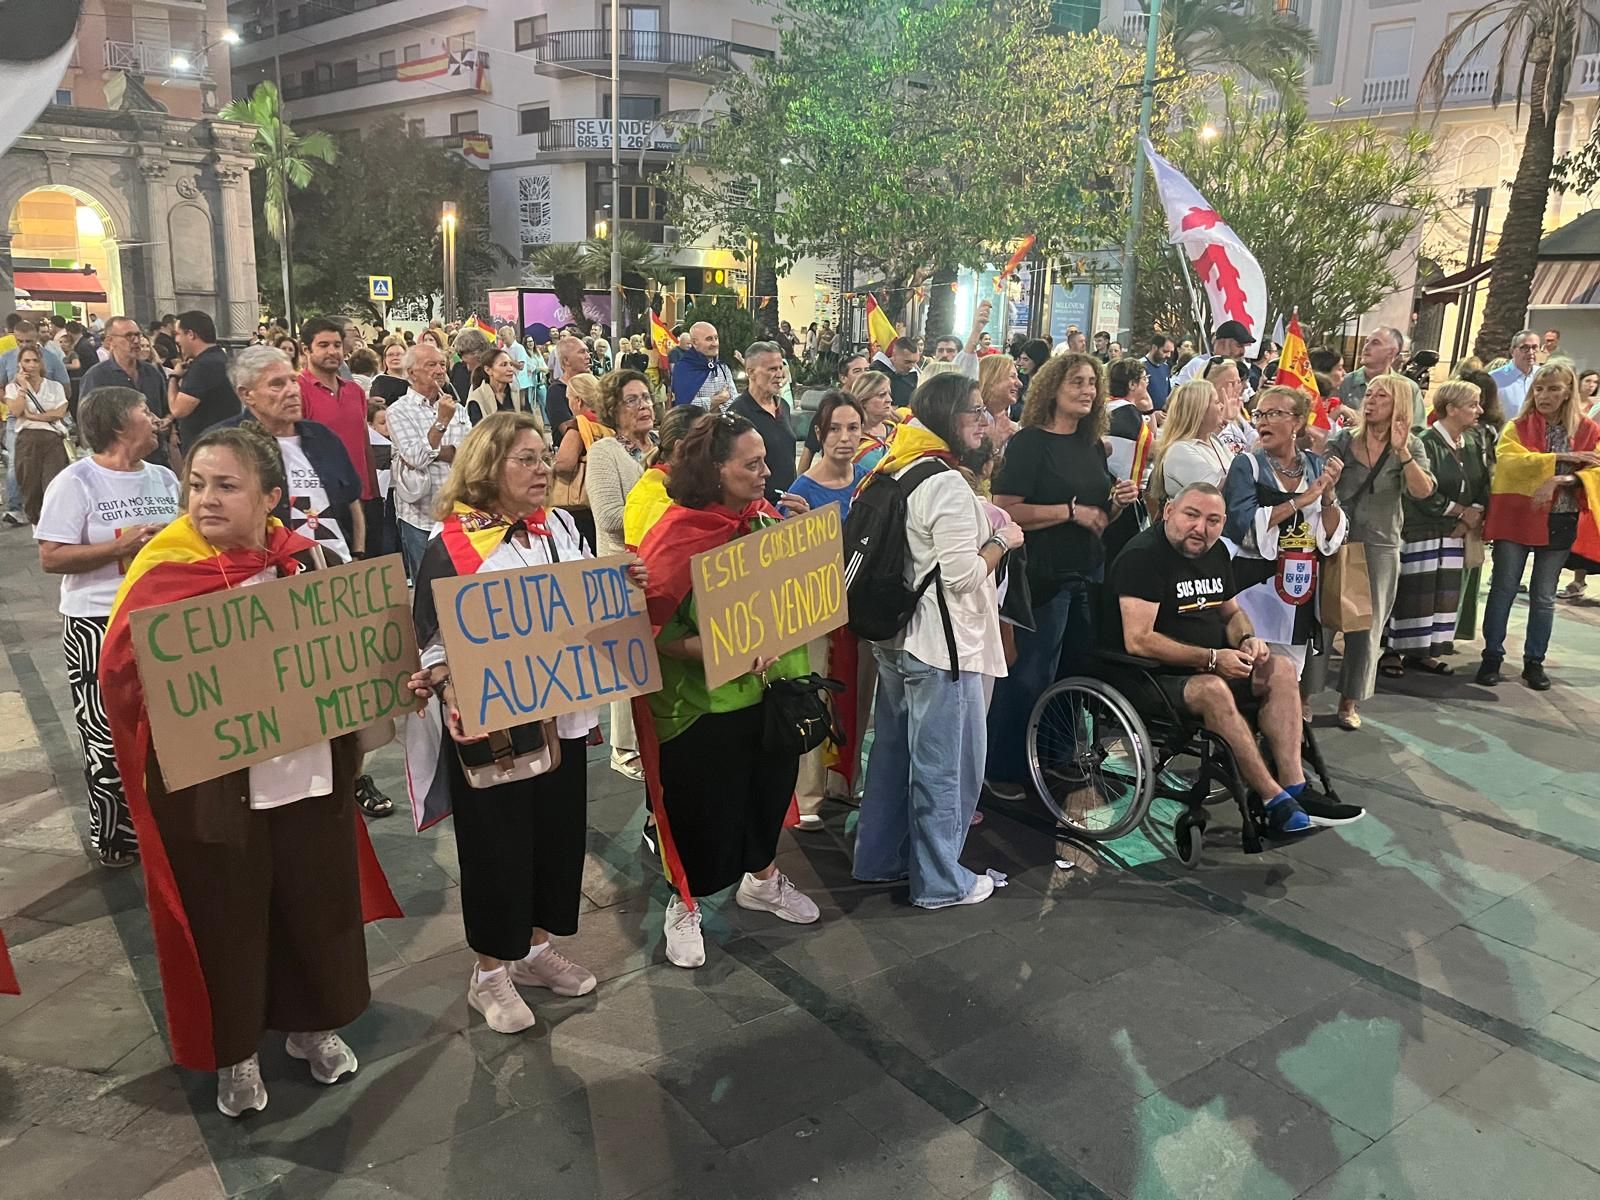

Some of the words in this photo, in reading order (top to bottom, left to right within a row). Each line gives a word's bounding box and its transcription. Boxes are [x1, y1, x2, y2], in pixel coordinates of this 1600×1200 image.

[577, 121, 594, 135] SE
[599, 120, 651, 136] VNDE
[577, 135, 599, 148] 685
[602, 135, 621, 148] 51
[291, 469, 306, 478] NO
[292, 479, 303, 488] SE
[98, 500, 127, 511] CEUTA
[128, 496, 144, 507] NO
[144, 496, 155, 505] SE
[102, 510, 132, 521] CEUTA
[133, 507, 144, 517] SE
[701, 542, 749, 593] ESTE
[759, 510, 838, 568] GOBIERNO
[147, 594, 274, 662] CEUTA
[288, 564, 403, 631] MERECE
[455, 573, 575, 645] CEUTA
[581, 564, 641, 624] PIDE
[710, 590, 765, 666] NOS
[770, 552, 841, 641] VENDIÓ
[1176, 580, 1194, 599] SUS
[166, 664, 223, 718] UN
[272, 621, 403, 693] FUTURO
[479, 638, 649, 726] AUXILIO
[214, 706, 281, 761] SIN
[314, 671, 417, 736] MIEDO
